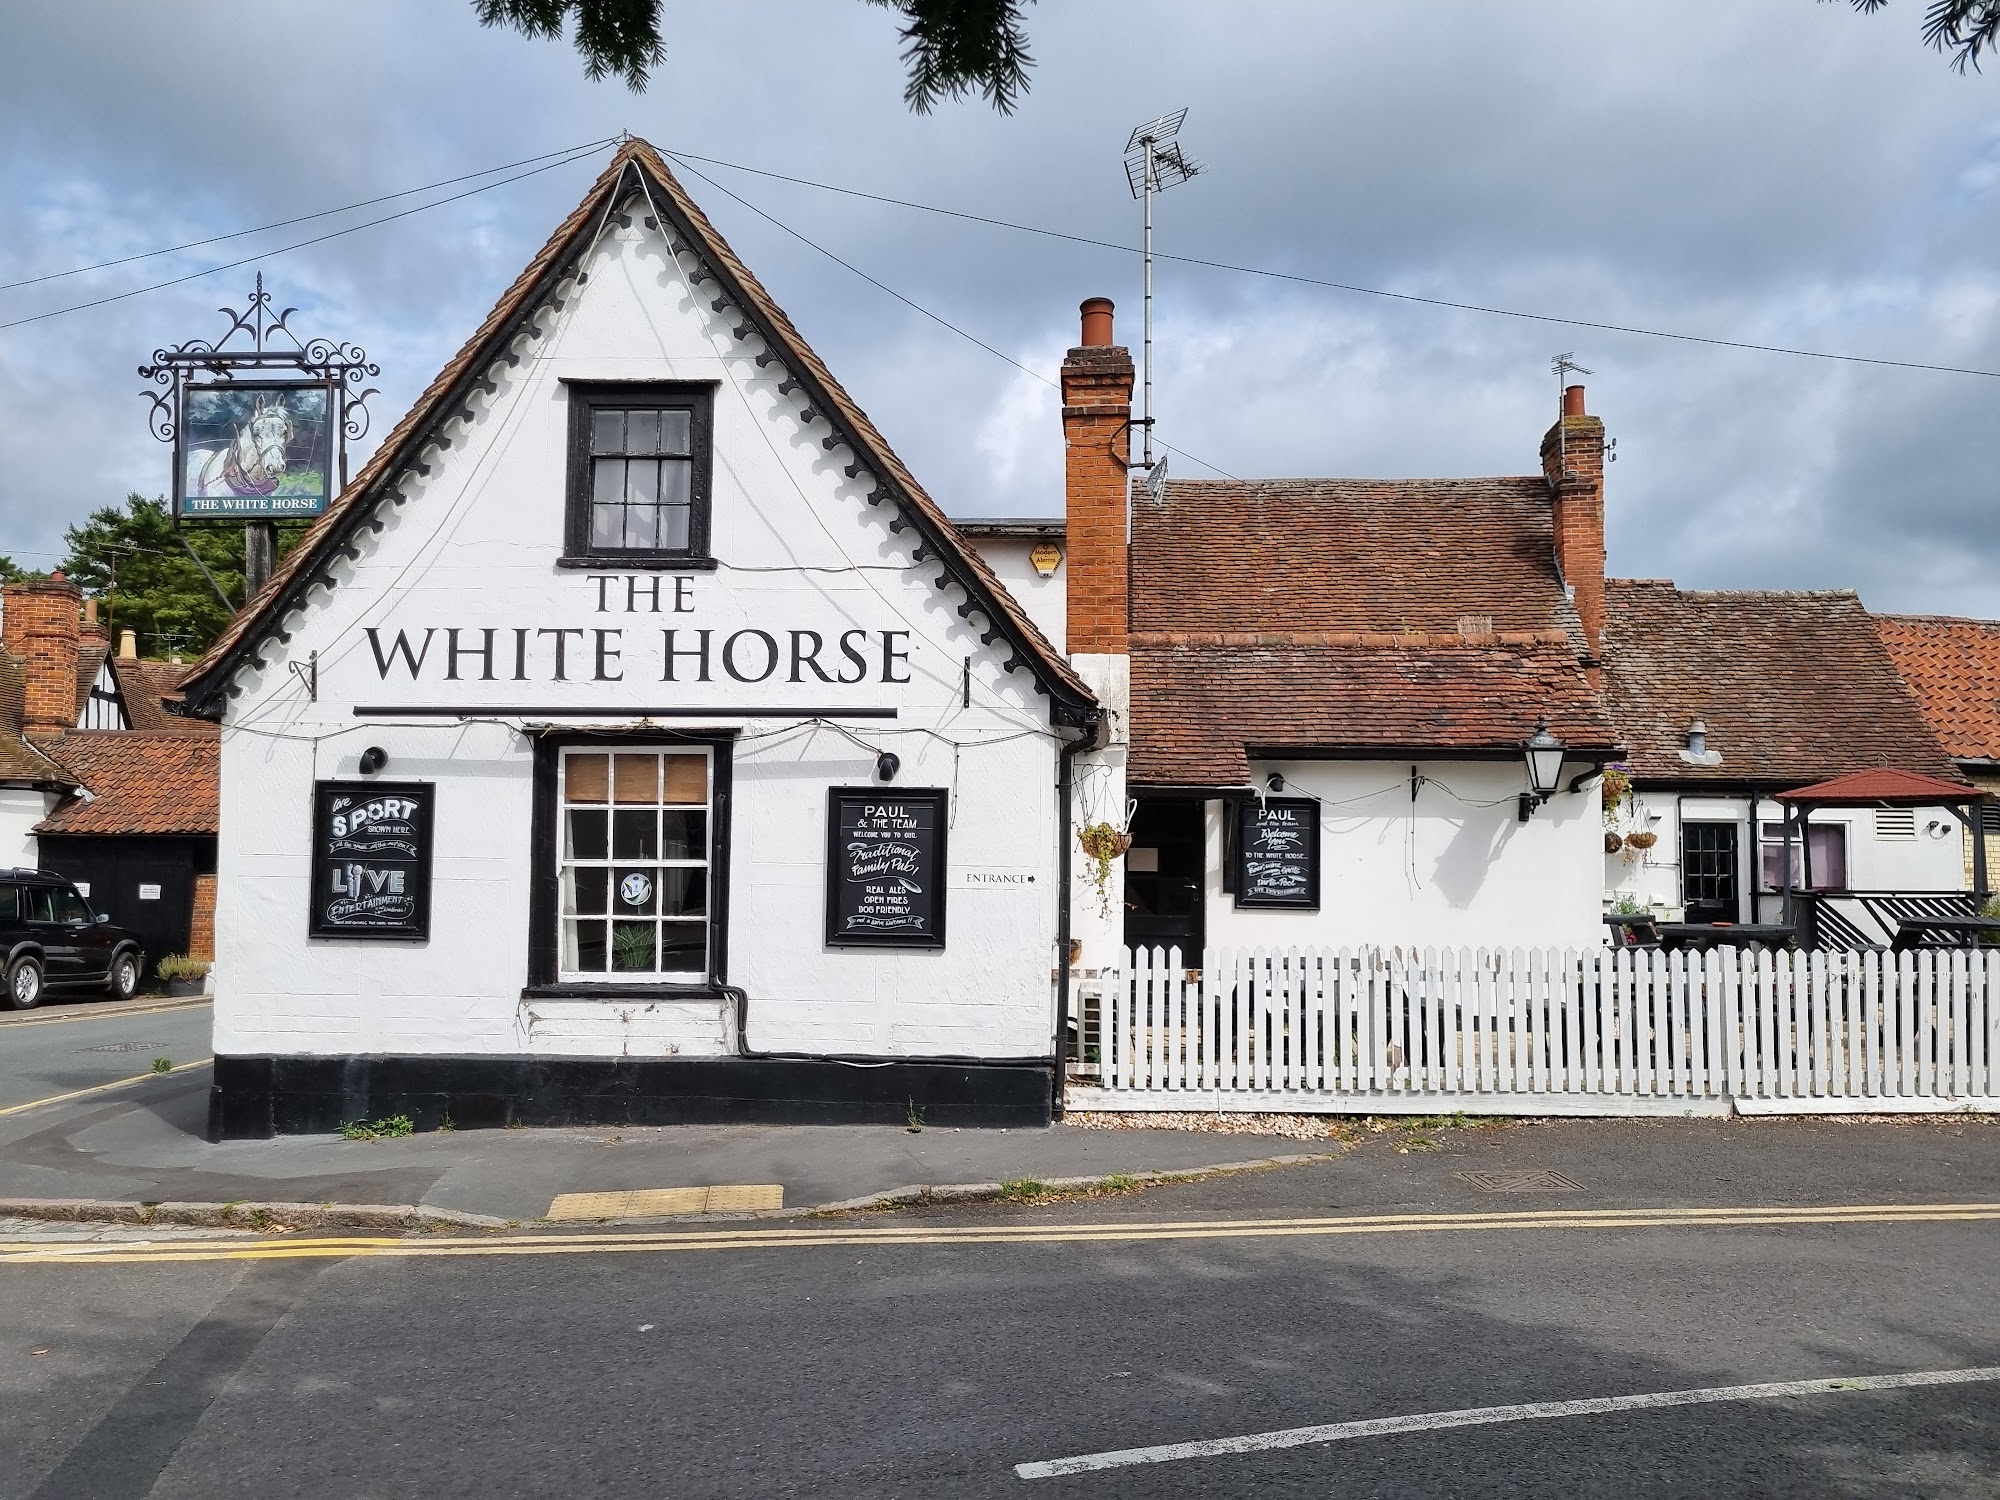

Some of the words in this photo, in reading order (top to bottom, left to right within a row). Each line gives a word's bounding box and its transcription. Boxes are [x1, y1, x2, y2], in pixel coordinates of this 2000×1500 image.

[192, 499, 219, 510] THE
[223, 499, 269, 510] WHITE
[272, 498, 317, 509] HORSE
[586, 575, 696, 613] THE
[362, 627, 625, 682] WHITE
[659, 629, 912, 685] HORSE
[864, 805, 910, 818] PAUL
[1258, 809, 1296, 820] PAUL
[332, 799, 418, 838] SPORT
[857, 818, 869, 828] &
[871, 818, 888, 829] THE
[891, 819, 918, 829] TEAM
[367, 825, 391, 833] SHOWN
[392, 826, 410, 834] HERE
[893, 831, 902, 839] TO
[1261, 827, 1300, 838] Welcome
[1267, 838, 1287, 850] You
[849, 843, 919, 864] Traditional
[851, 857, 891, 876] Family
[332, 864, 404, 897] LIVE
[966, 873, 1026, 883] ENTRANCE
[866, 885, 886, 894] REAL
[888, 886, 907, 894] ALES
[331, 896, 404, 915] ENTERTAINMENT
[863, 896, 884, 904] OPEN
[886, 896, 909, 905] FIRES
[858, 905, 874, 914] DOG
[875, 906, 911, 914] FRIENDLY
